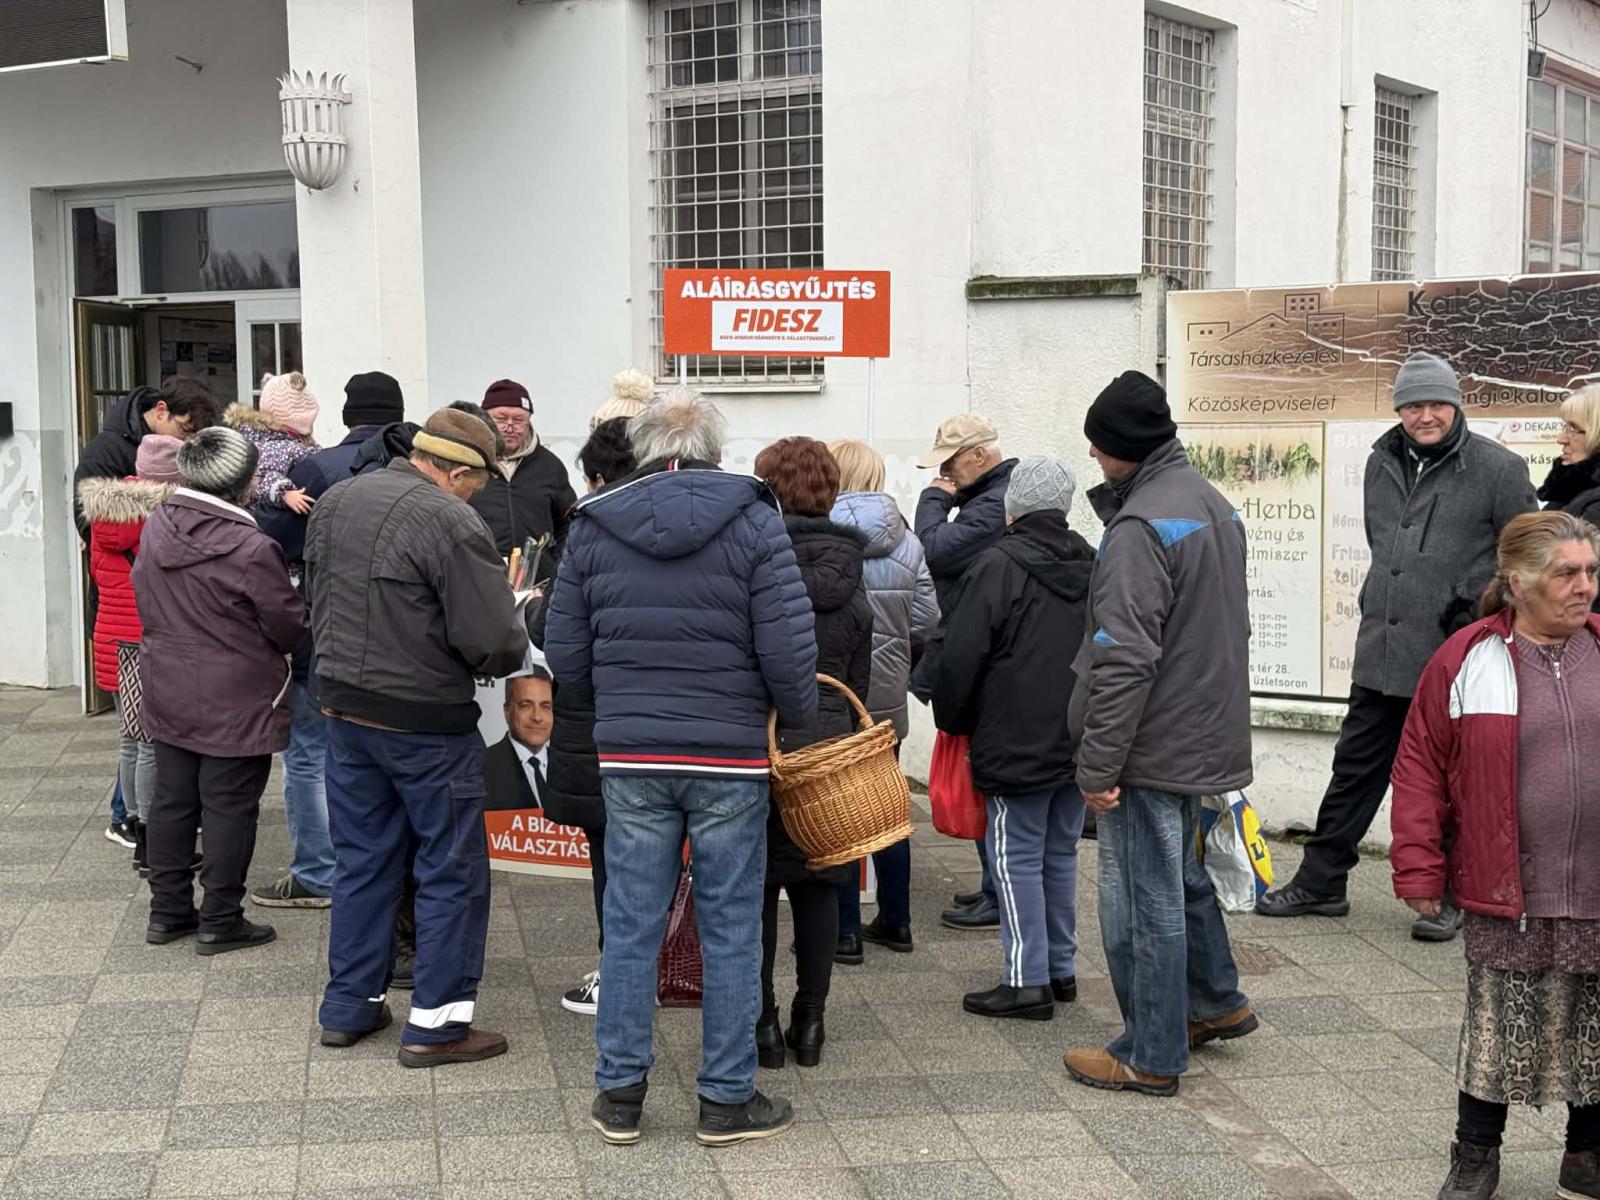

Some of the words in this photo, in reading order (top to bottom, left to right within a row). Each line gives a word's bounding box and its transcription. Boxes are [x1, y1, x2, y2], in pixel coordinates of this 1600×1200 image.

[680, 276, 877, 300] ALÁÍRÁSGYŰJTÉS
[732, 308, 823, 333] FIDESZ
[1188, 394, 1338, 414] Közösképviselet
[1246, 526, 1282, 545] vény
[511, 814, 525, 832] A
[490, 830, 591, 859] VÁLASZTÁS
